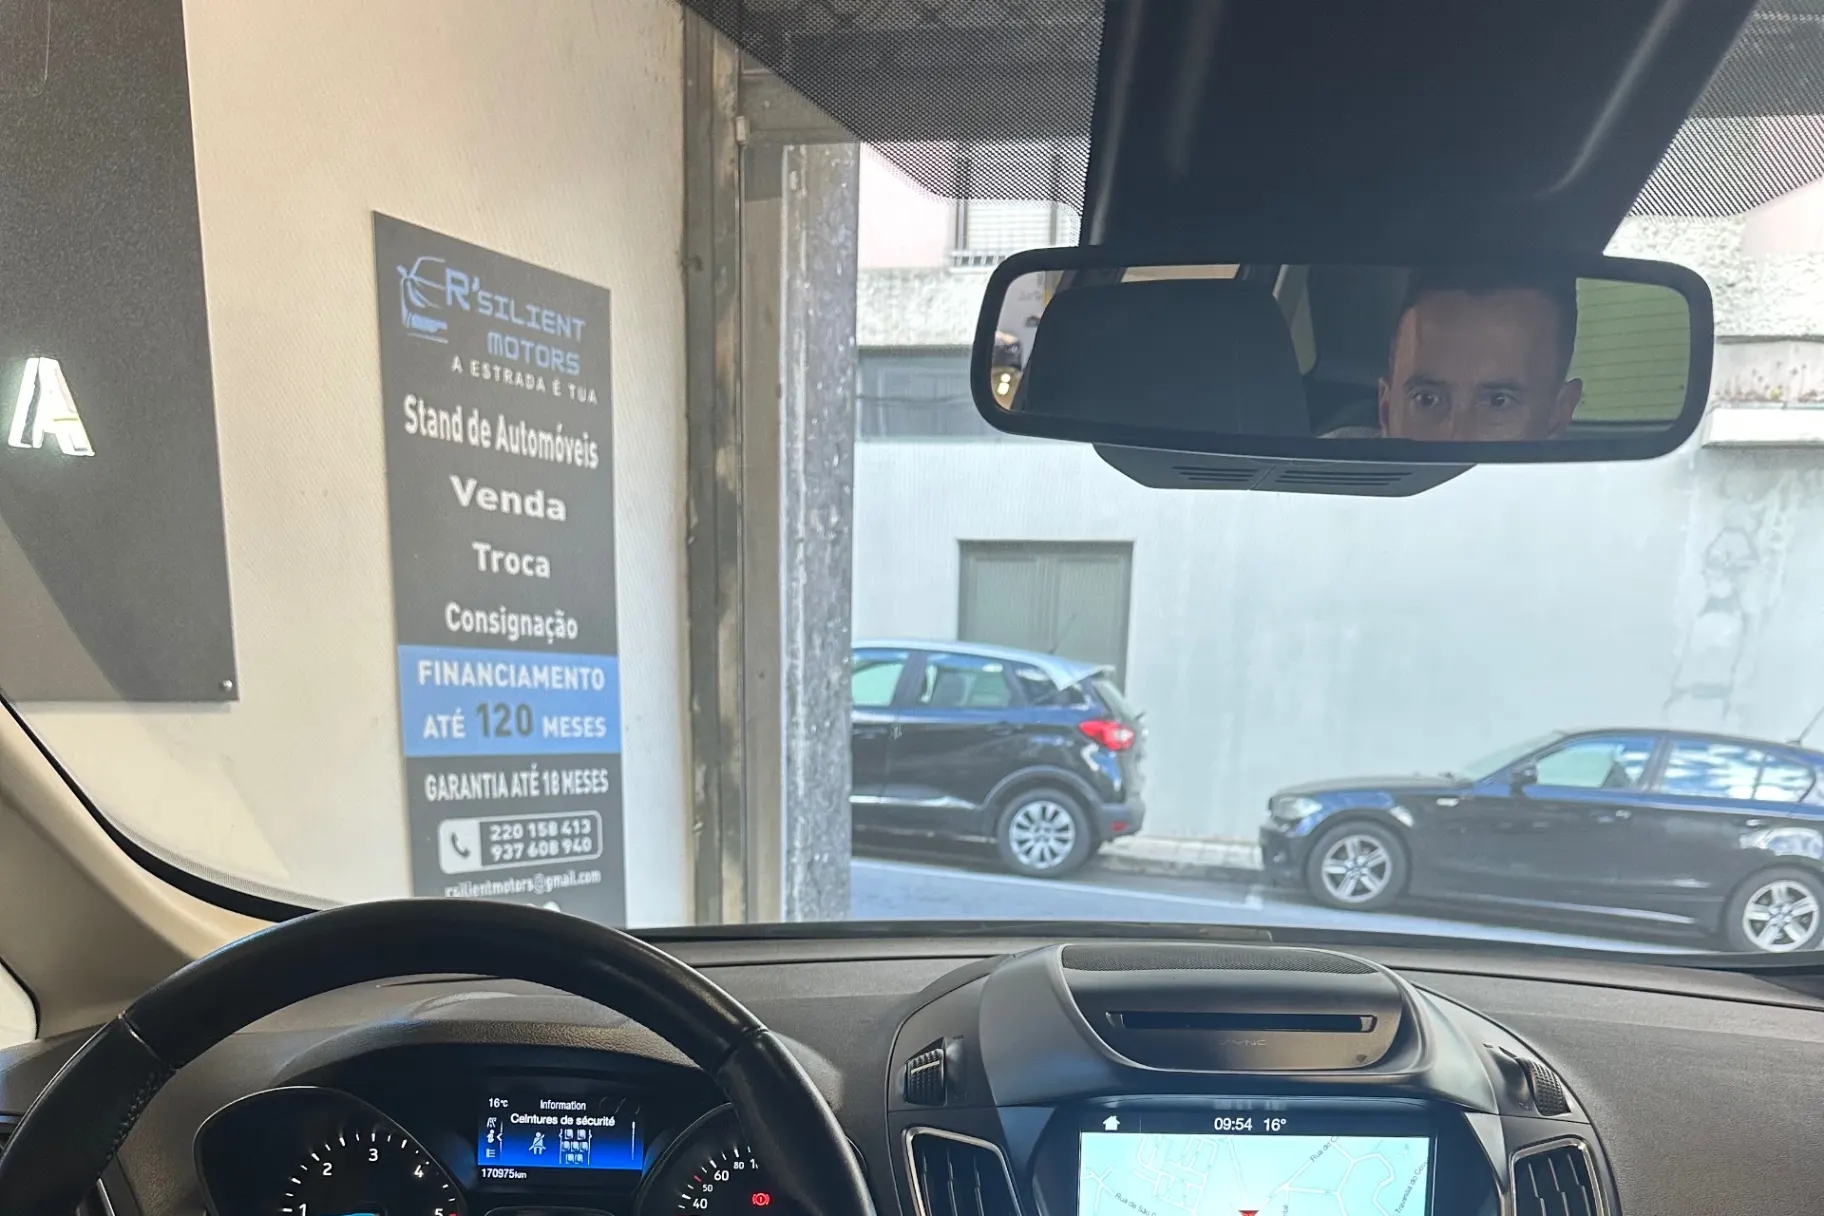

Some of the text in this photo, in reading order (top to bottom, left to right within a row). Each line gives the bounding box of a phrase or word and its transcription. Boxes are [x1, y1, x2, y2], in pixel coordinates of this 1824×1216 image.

[487, 331, 580, 376] MOTORS
[451, 355, 463, 373] A
[470, 360, 546, 393] ESTRADA
[568, 384, 598, 404] TUA
[403, 394, 599, 469] Stand de Automóveis
[449, 474, 567, 521] Venda
[471, 540, 550, 579] Troca
[444, 602, 578, 644] Consignação
[418, 659, 606, 690] FINANCIAMENTO
[423, 702, 607, 739] ATÉ 120 MESES
[424, 763, 609, 801] GARANTIA ATÉ 18 MESES
[489, 823, 524, 841] 220
[560, 818, 592, 836] 413
[490, 837, 593, 861] 937 608 940
[540, 1099, 586, 1111] Information
[510, 1113, 616, 1127] Ceintures de sécurité
[1214, 1117, 1287, 1132] 09:54 16°
[368, 1148, 379, 1162] 3
[1309, 1150, 1323, 1162] Rua
[322, 1162, 333, 1176] 2
[413, 1164, 424, 1178] 4
[733, 1162, 745, 1170] 80
[714, 1170, 730, 1181] 60
[702, 1184, 714, 1192] 50
[692, 1198, 708, 1209] 40
[1115, 1192, 1128, 1205] Rua
[1128, 1200, 1137, 1209] de
[299, 1203, 307, 1216] 1
